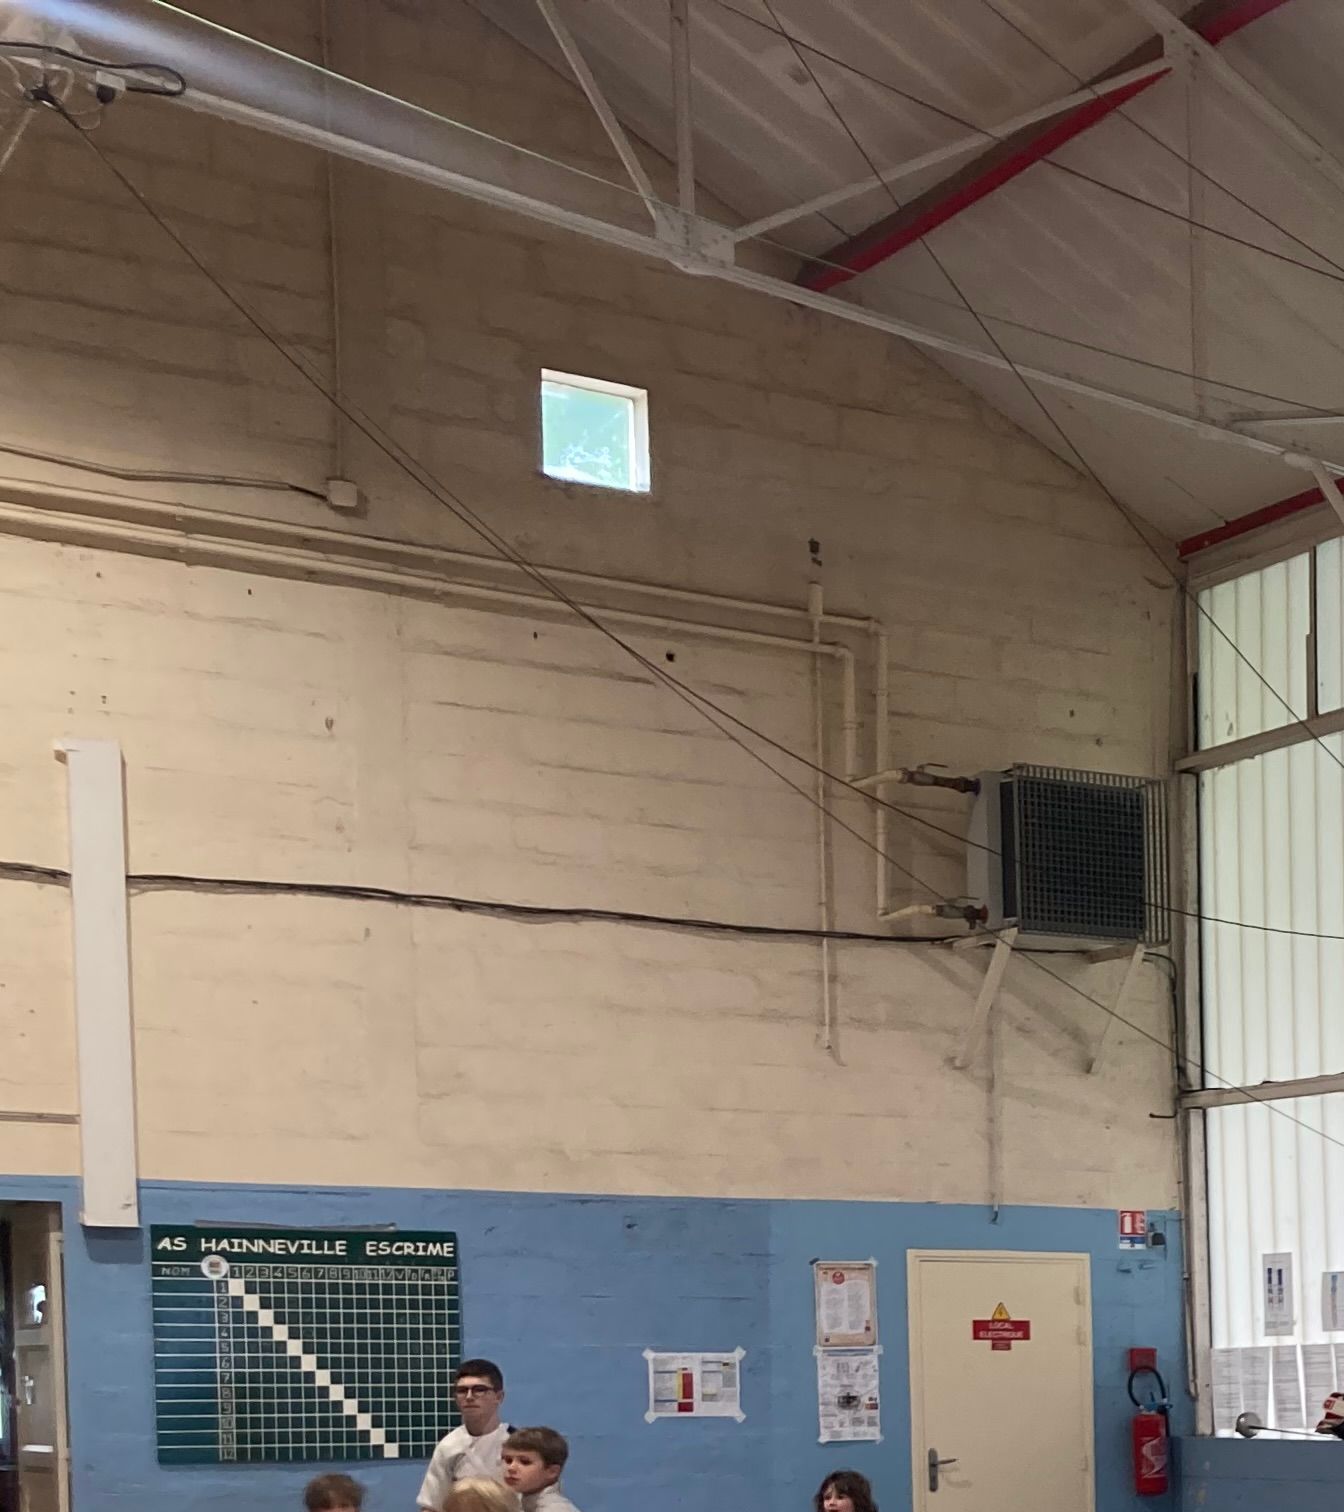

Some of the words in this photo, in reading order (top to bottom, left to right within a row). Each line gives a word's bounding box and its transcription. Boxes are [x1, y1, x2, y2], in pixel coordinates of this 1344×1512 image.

[157, 1236, 188, 1251] AS
[200, 1237, 348, 1256] HAINNEVILLE
[365, 1240, 455, 1257] ESCRIME
